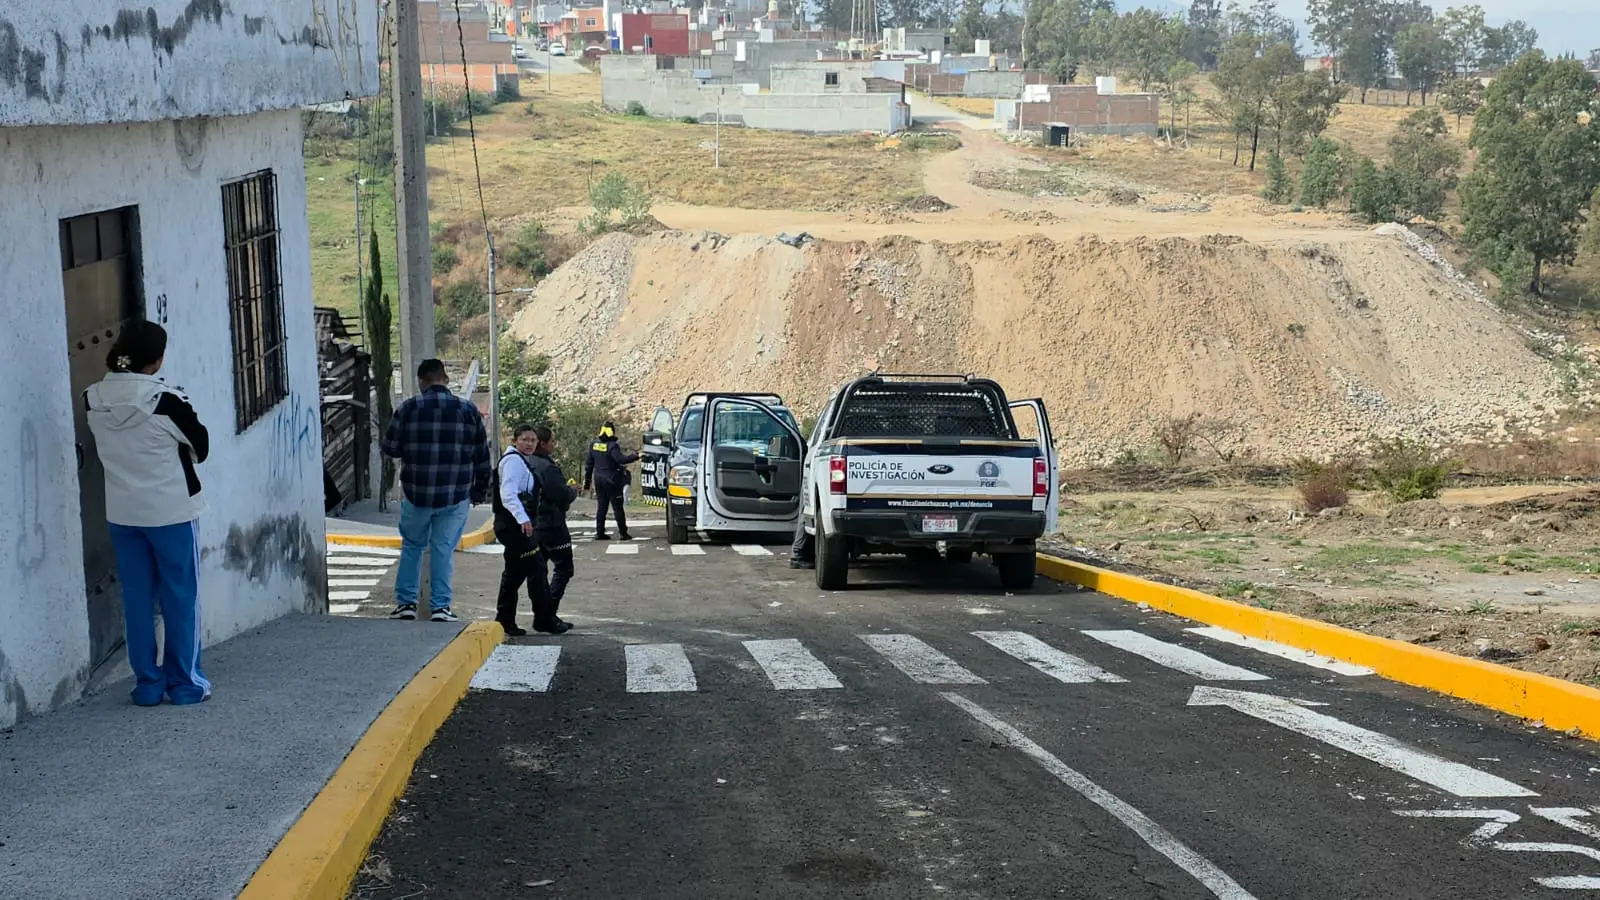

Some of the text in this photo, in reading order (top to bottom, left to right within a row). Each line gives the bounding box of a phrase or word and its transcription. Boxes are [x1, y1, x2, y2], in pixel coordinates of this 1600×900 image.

[849, 460, 903, 470] POLICÍA DE
[848, 470, 925, 480] INVESTIGACIÓN
